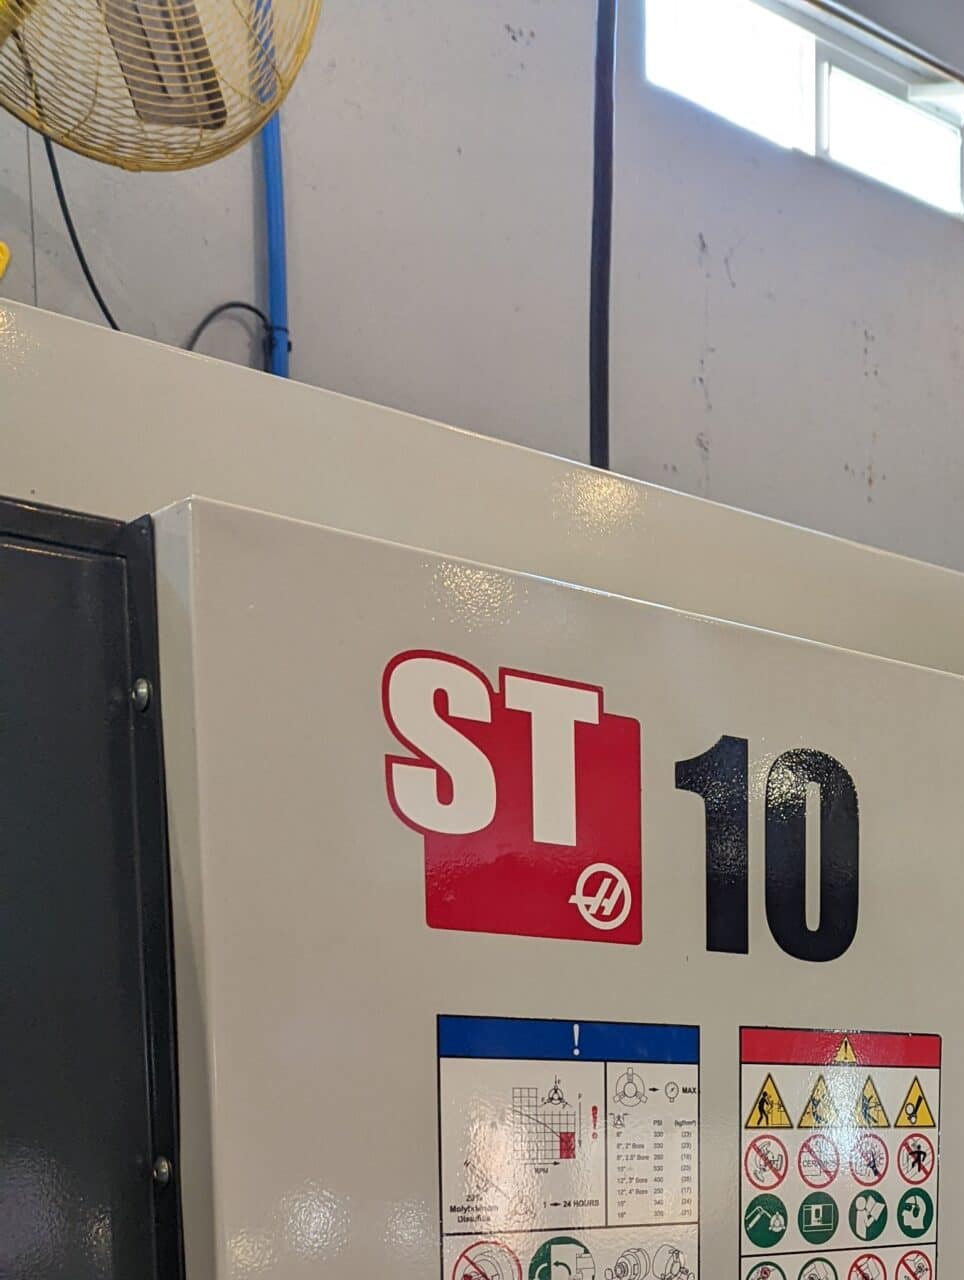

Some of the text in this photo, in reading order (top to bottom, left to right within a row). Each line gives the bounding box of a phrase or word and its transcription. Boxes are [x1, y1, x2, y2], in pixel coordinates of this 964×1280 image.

[386, 655, 860, 963] ST 10
[573, 1199, 600, 1208] HOURS
